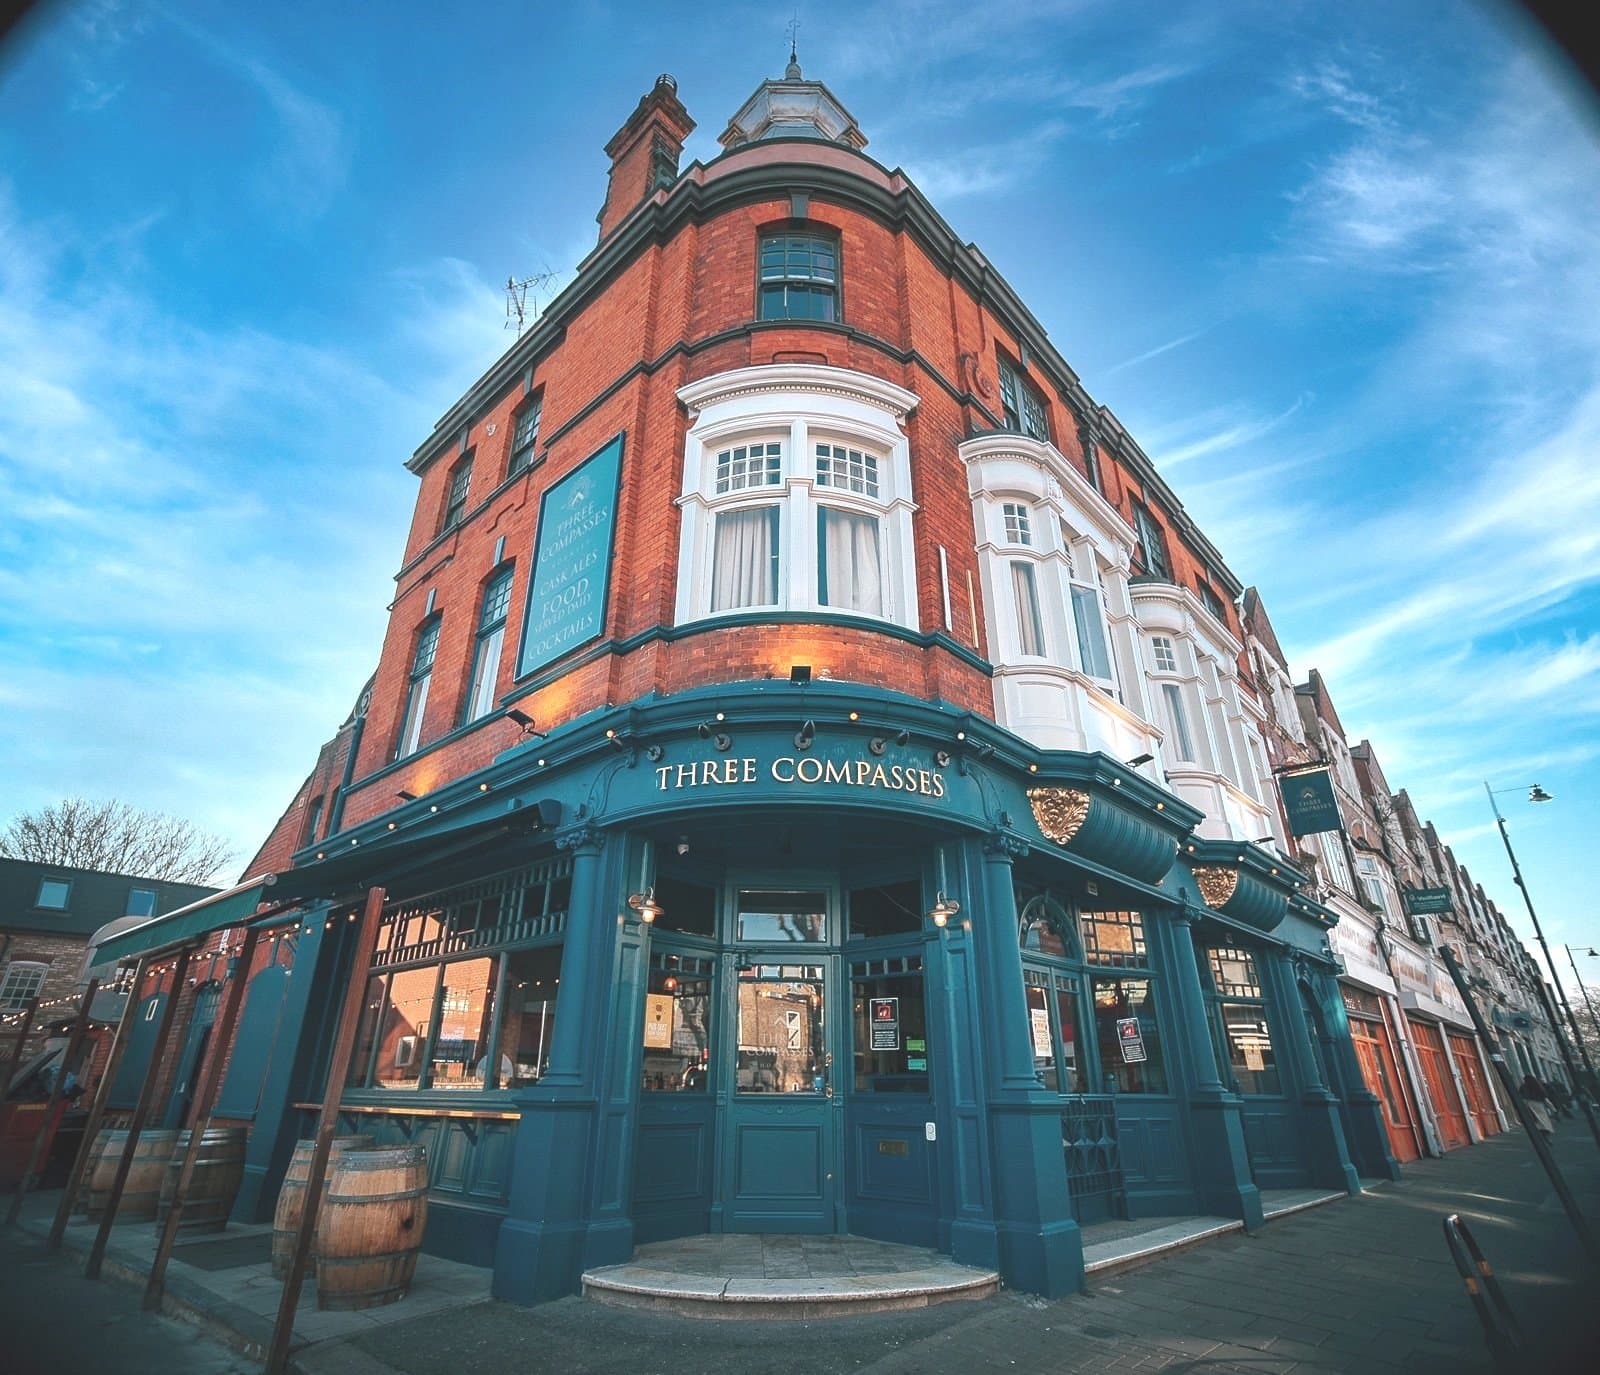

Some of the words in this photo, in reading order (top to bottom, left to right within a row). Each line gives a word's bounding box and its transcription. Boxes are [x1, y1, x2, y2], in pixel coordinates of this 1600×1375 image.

[541, 506, 608, 562] COMPASSES
[557, 501, 595, 537] THREE
[540, 571, 568, 596] CASK
[571, 549, 598, 576] ALES
[542, 578, 589, 619] FOOD
[529, 612, 593, 660] COCKTAILS
[656, 758, 757, 790] THREE
[771, 757, 944, 797] COMPASSES
[746, 1046, 814, 1057] COMPASSES
